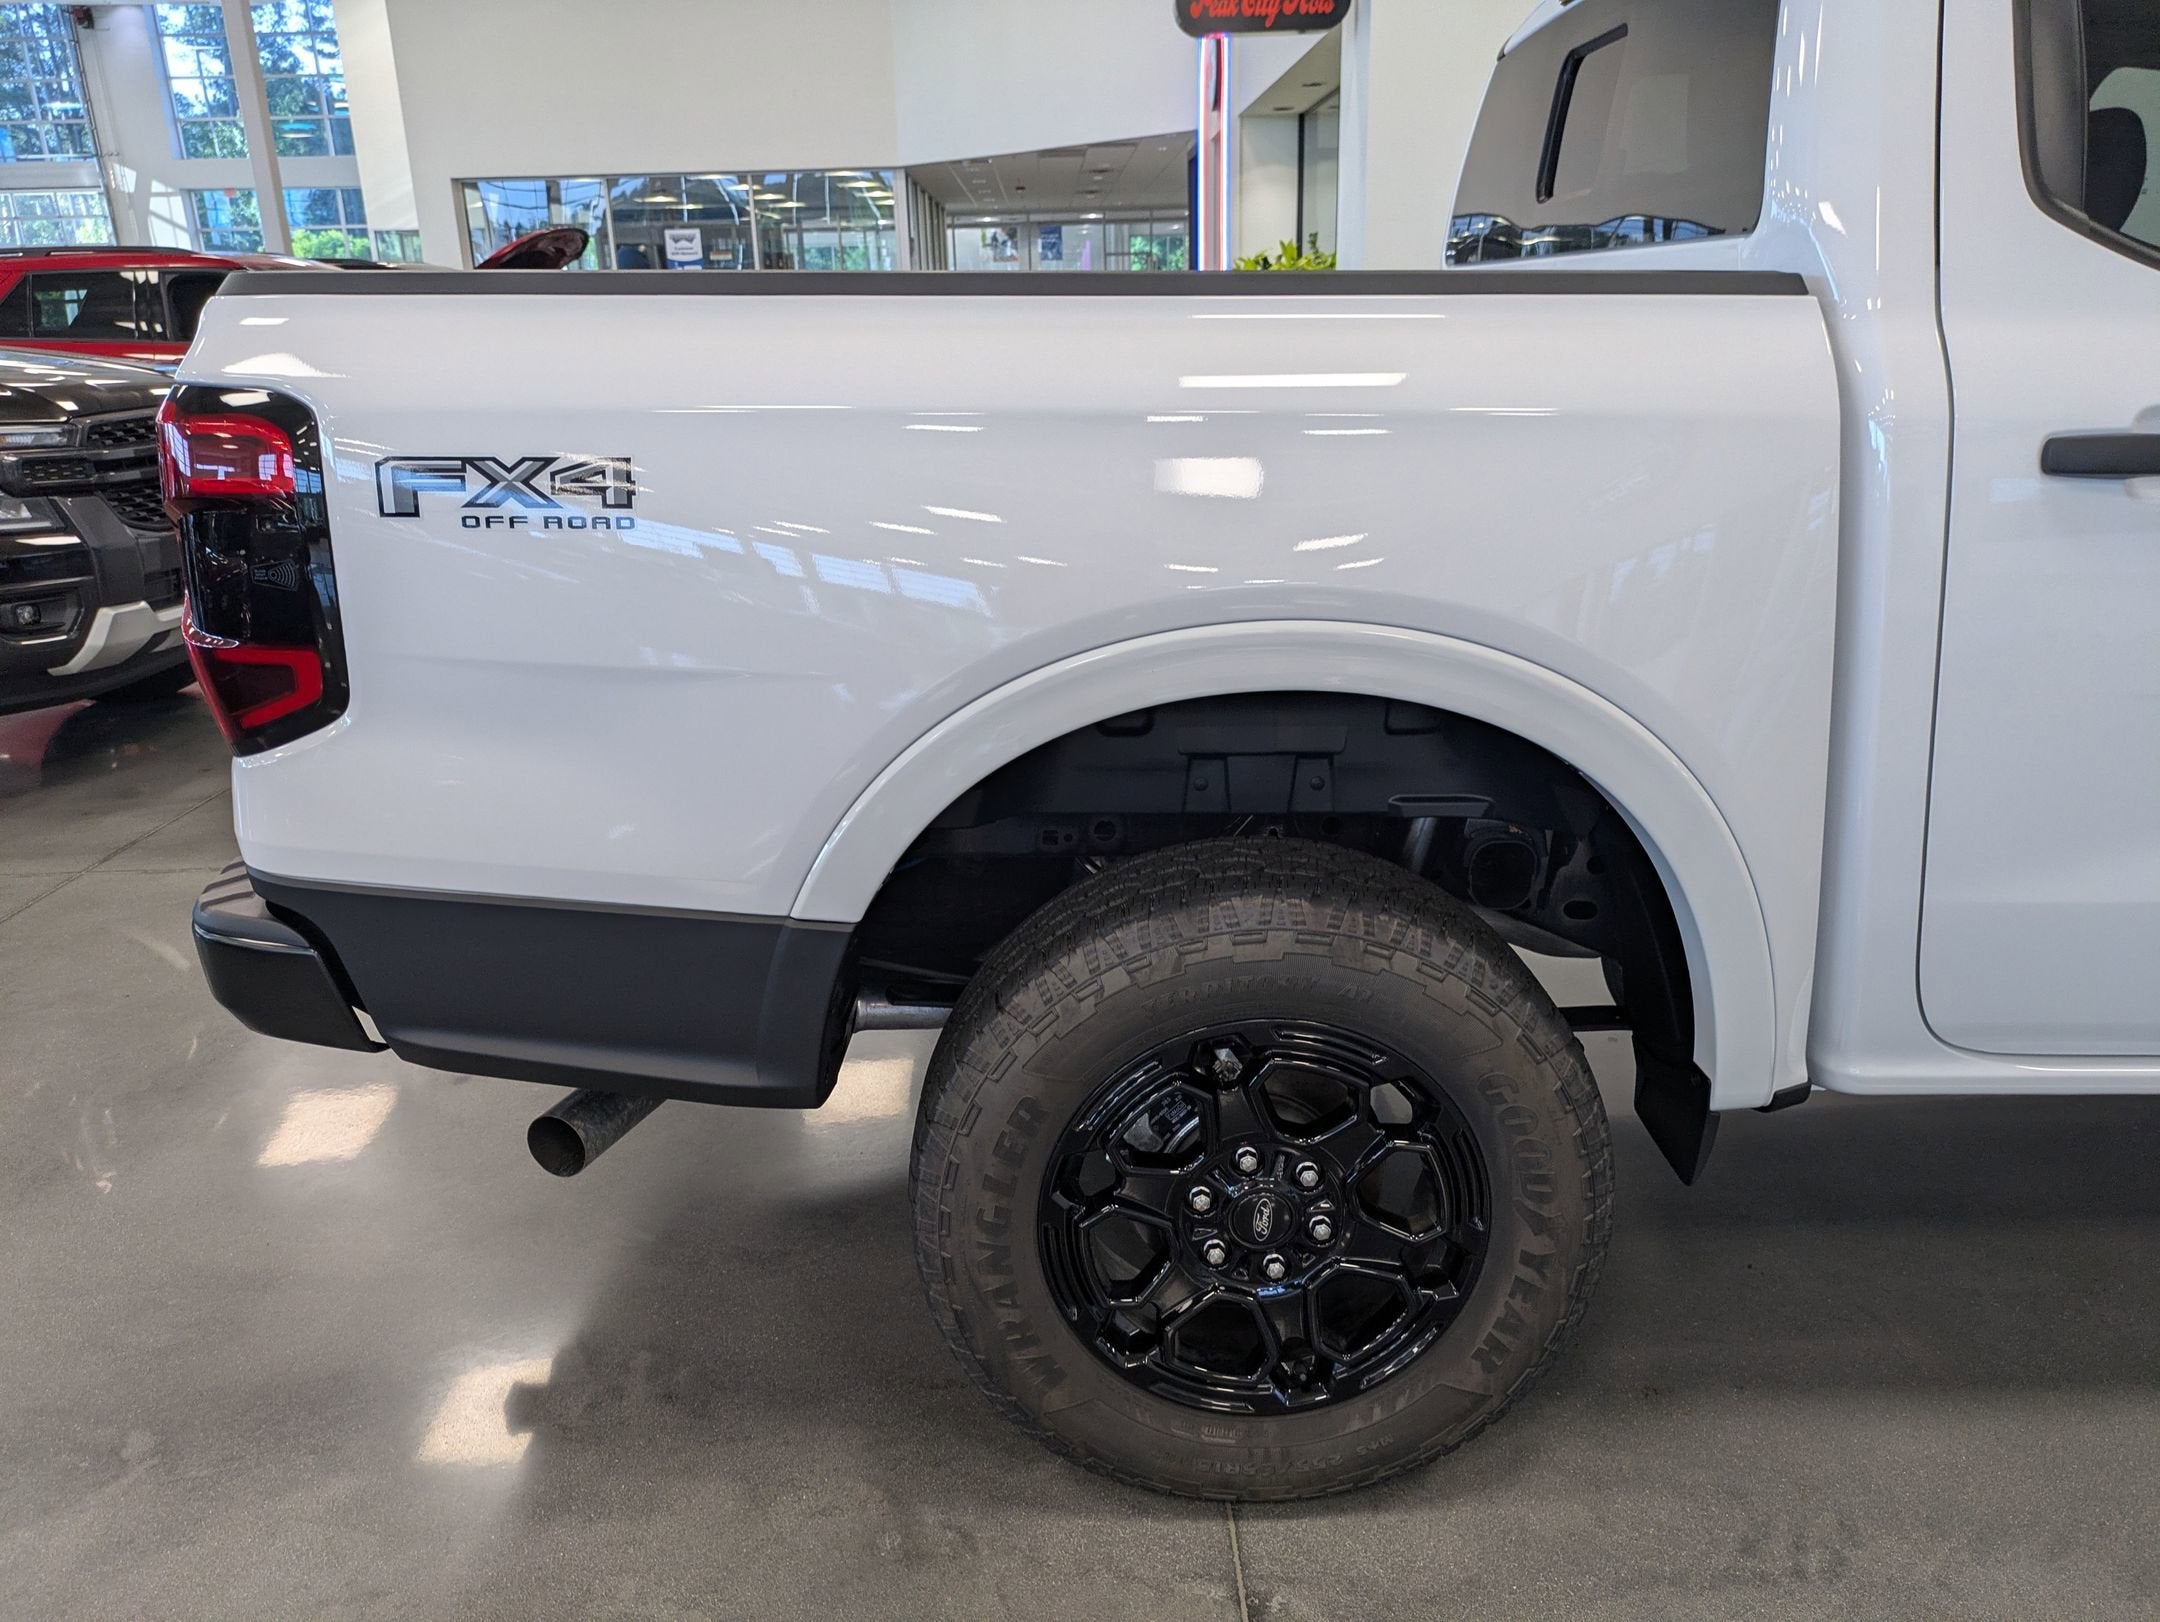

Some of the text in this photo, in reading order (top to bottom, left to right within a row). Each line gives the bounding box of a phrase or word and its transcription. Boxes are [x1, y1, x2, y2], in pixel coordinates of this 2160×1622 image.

[374, 455, 636, 518] FX4
[461, 515, 636, 530] OFF ROAD
[974, 1095, 1068, 1390] WRANGLER
[1255, 1203, 1271, 1236] Ford
[1470, 1071, 1563, 1374] GOODYEAR
